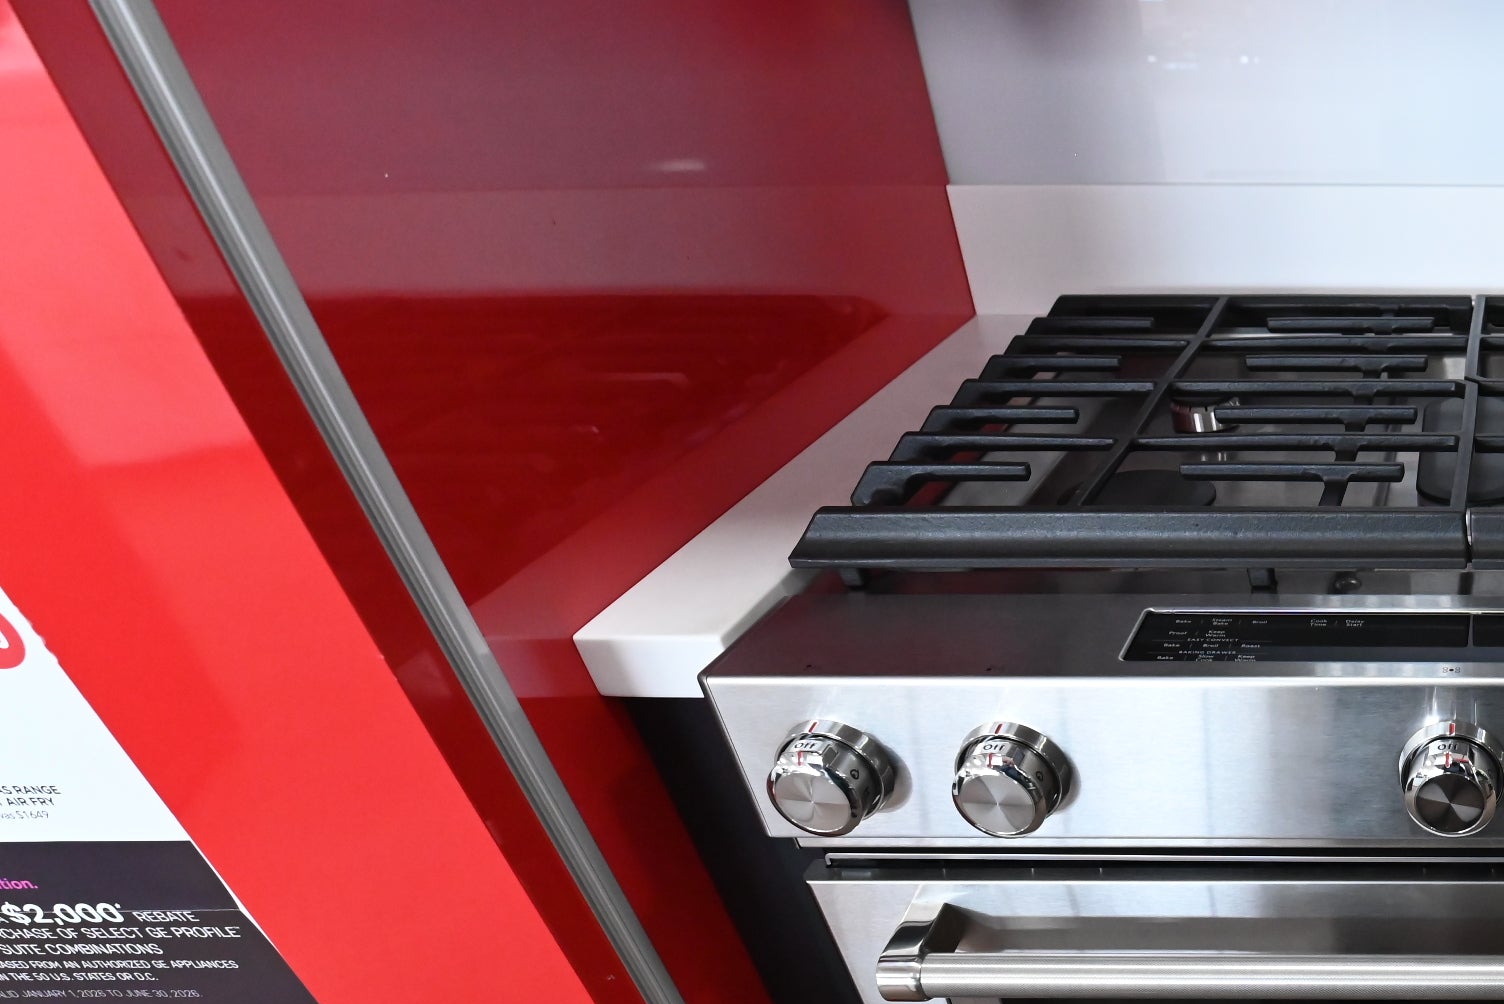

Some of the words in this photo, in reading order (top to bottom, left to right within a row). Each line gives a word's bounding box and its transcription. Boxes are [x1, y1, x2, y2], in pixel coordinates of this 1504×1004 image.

[794, 741, 816, 750] Off
[983, 743, 1007, 752] Off
[1437, 742, 1458, 751] Off
[12, 785, 62, 795] RANGE
[6, 797, 29, 806] AIR
[29, 797, 55, 806] FRY
[16, 810, 49, 819] $1649
[132, 911, 200, 922] REBATE
[56, 928, 78, 938] OF
[81, 927, 143, 938] SELECT
[145, 927, 172, 938] GE
[0, 944, 46, 955] SUITE
[44, 943, 164, 955] COMBINATIONS
[29, 961, 62, 969] FROM
[63, 961, 81, 969] AN
[81, 961, 151, 969] AUTHORIZED
[151, 960, 170, 969] GE
[170, 960, 239, 969] APPLIANCES
[8, 973, 34, 981] THE
[33, 973, 50, 981] 50
[73, 973, 116, 981] STATES
[116, 973, 135, 981] OR
[134, 972, 159, 981] D.C.
[22, 990, 67, 998] JANUARY
[105, 990, 123, 998] TO
[125, 990, 153, 998] JUNE
